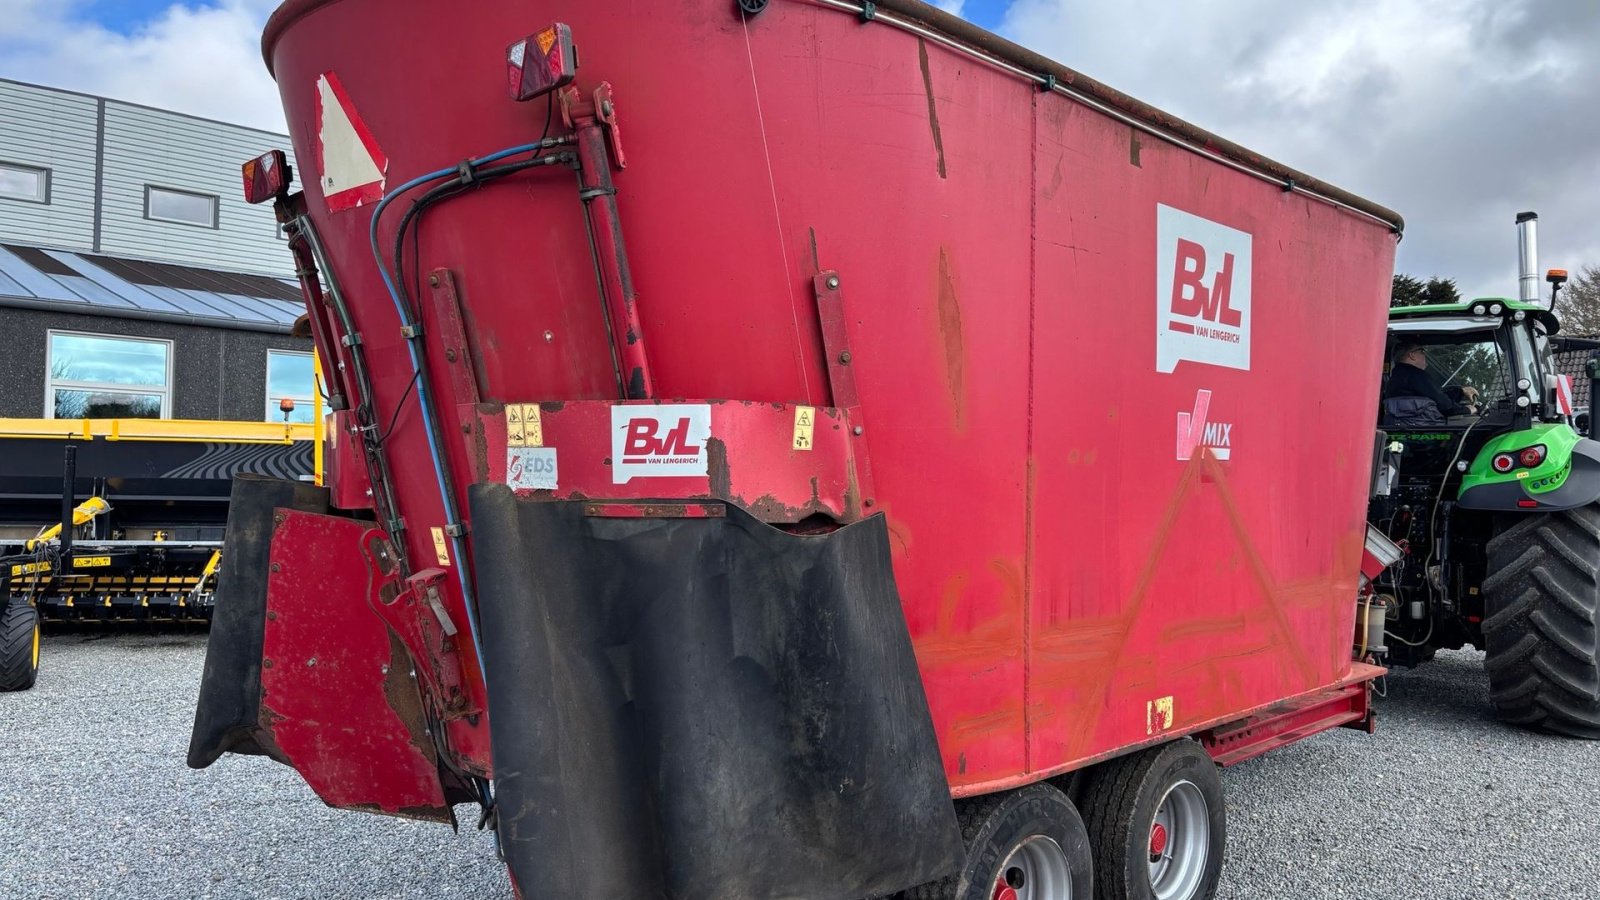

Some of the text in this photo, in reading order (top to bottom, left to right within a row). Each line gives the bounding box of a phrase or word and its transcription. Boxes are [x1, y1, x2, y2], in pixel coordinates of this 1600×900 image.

[1196, 325, 1241, 344] VAN LENGERICH
[1203, 422, 1233, 447] MIX
[662, 457, 699, 465] LENGERICH
